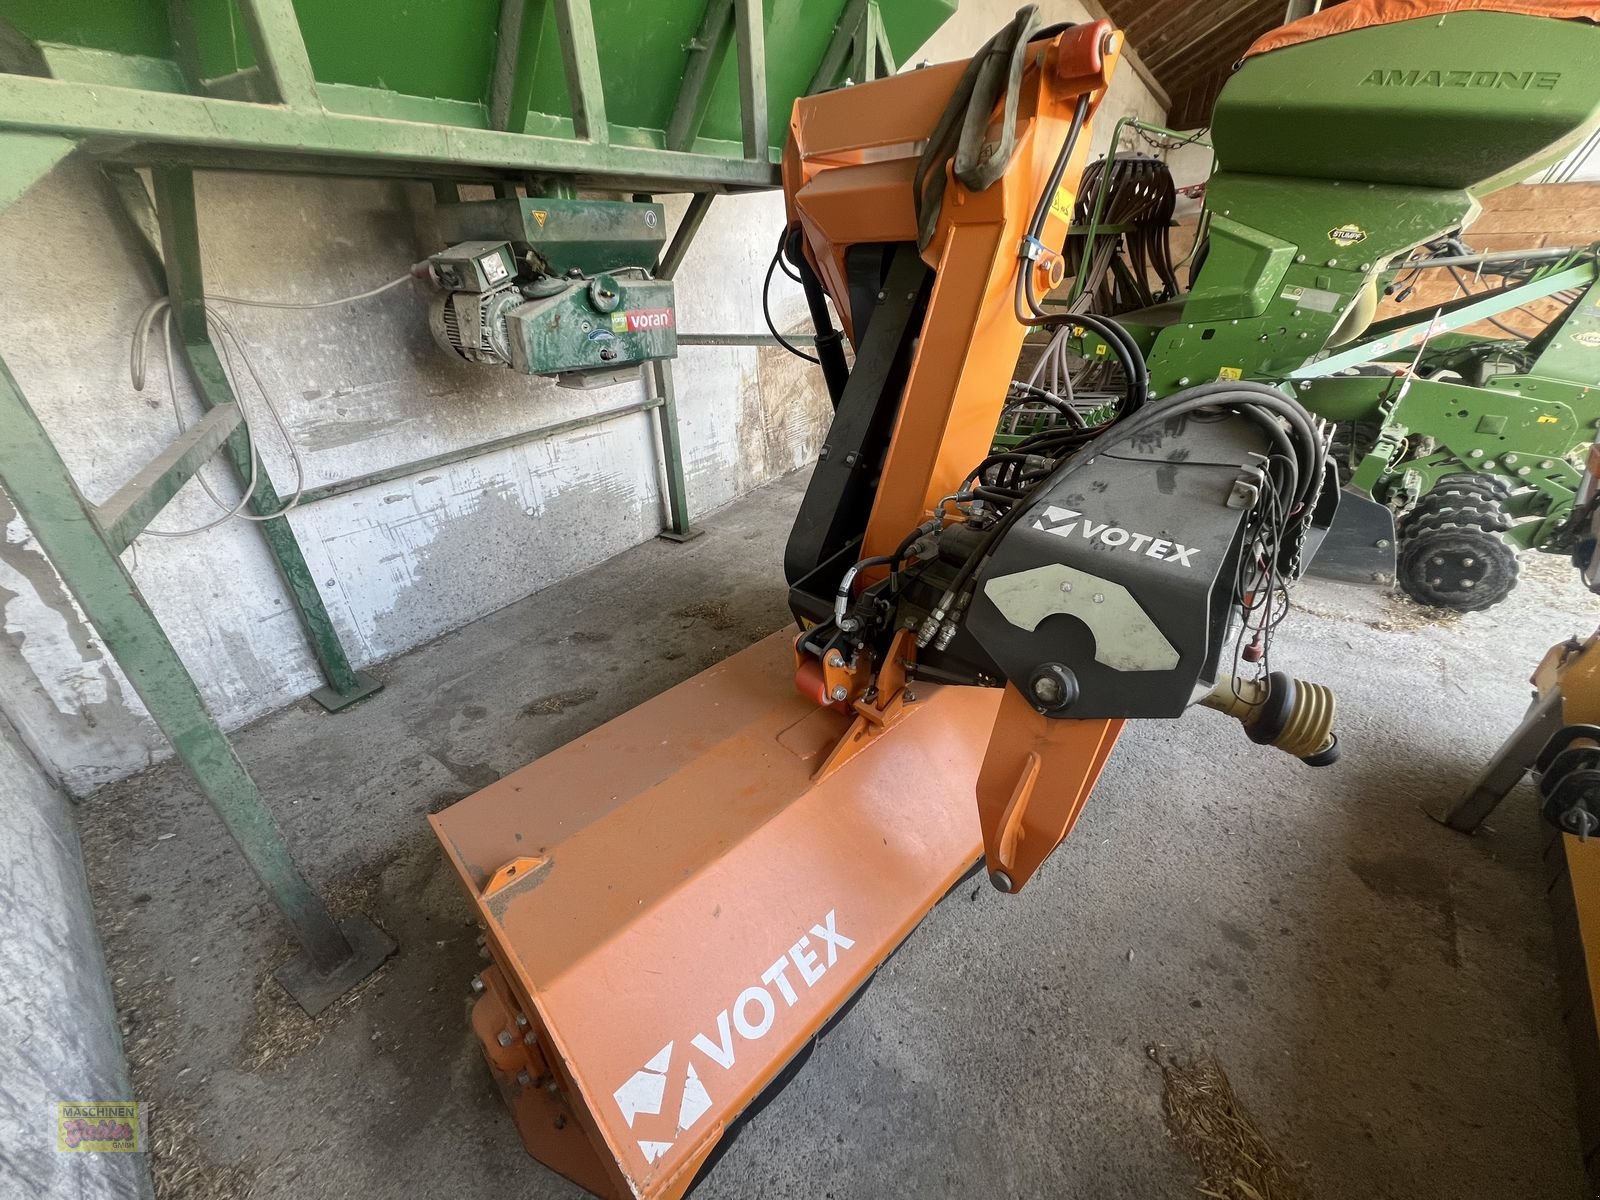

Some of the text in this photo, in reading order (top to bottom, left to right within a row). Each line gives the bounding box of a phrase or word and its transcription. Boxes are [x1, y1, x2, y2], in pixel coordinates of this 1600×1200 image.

[1358, 70, 1562, 91] AMAZONE
[1332, 230, 1363, 240] STUMPF
[1082, 519, 1201, 568] VOTEX
[690, 908, 856, 1070] VOTEX
